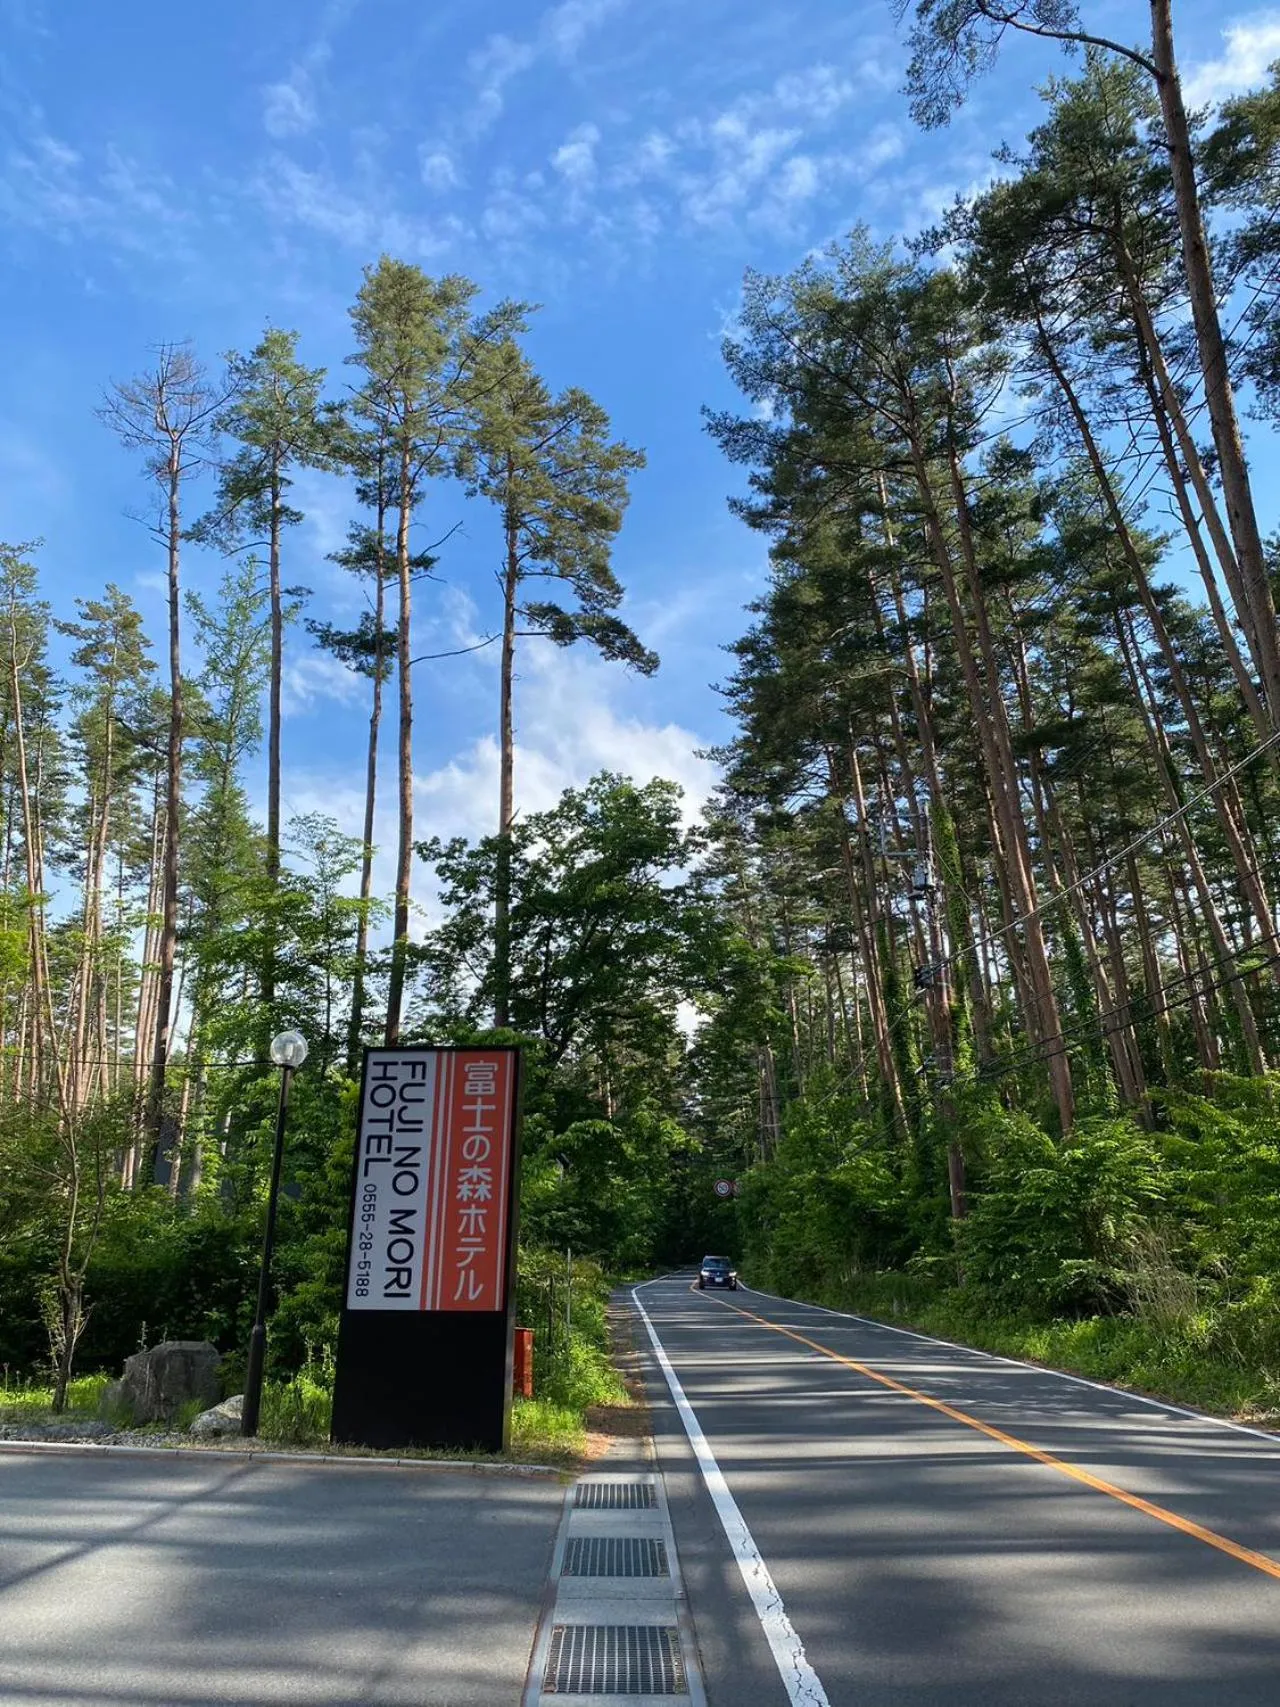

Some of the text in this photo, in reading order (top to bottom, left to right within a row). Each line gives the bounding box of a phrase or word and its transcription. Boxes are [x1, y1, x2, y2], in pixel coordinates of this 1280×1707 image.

[355, 1061, 399, 1297] HOTEL 0555-28-5188
[383, 1060, 427, 1298] FUJI NO MORI
[453, 1060, 498, 1301] 富士の森ホテル
